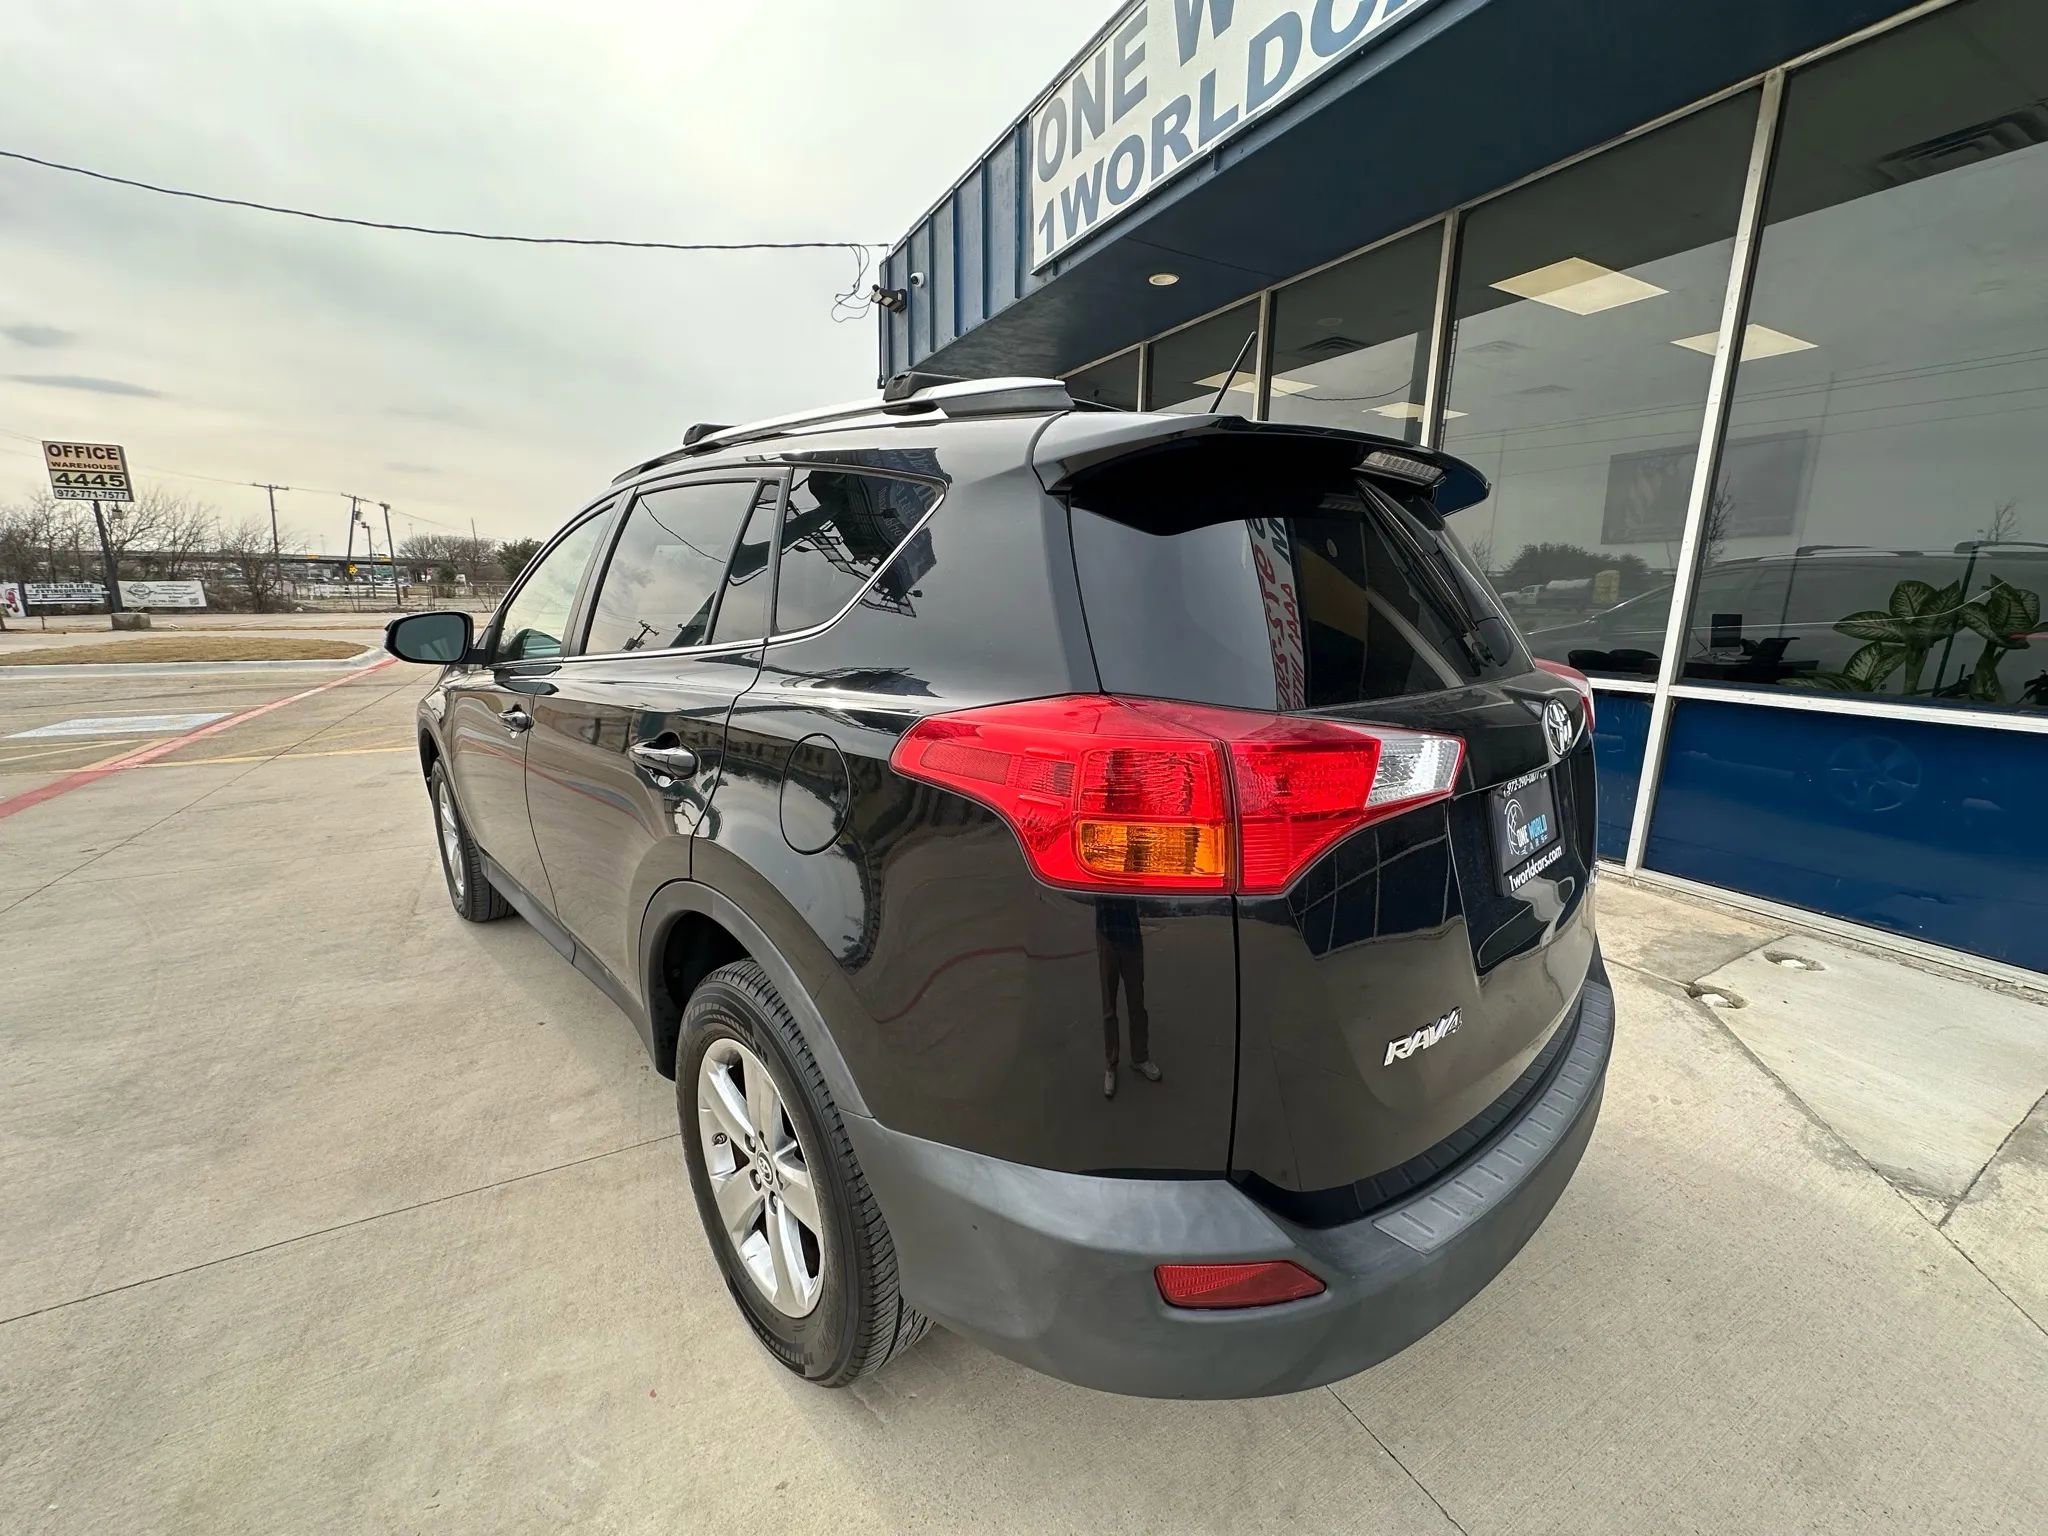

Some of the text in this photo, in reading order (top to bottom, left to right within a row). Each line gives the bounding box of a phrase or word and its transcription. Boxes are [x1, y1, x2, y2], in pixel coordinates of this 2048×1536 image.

[1037, 7, 1148, 183] ONE
[47, 444, 119, 460] OFFICE
[51, 462, 121, 470] WAREHOUSE
[55, 472, 125, 487] 4445
[57, 489, 127, 499] 972-771-7577
[1516, 813, 1548, 848] ONE WORLD
[1508, 845, 1563, 892] 1worldcars.com
[1383, 1006, 1463, 1067] RAV4
